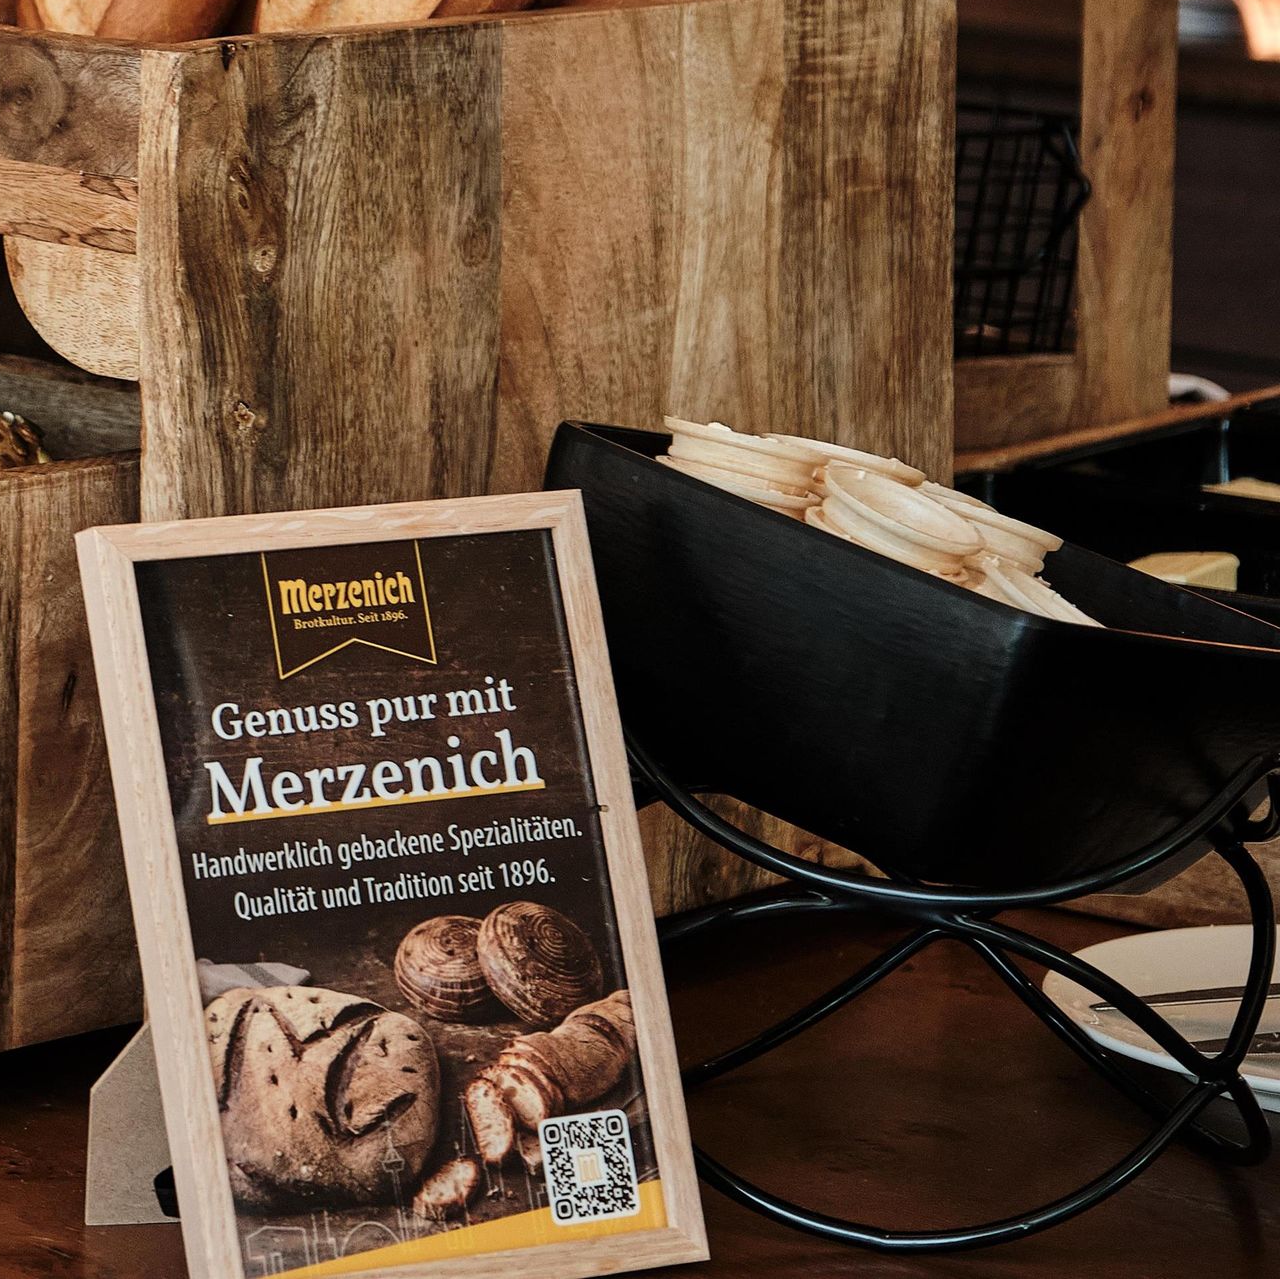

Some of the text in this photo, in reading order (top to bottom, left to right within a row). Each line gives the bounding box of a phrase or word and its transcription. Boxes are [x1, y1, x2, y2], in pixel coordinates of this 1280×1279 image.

[293, 609, 409, 630] Brotkultur. Seit 1896.
[211, 676, 518, 741] Genuss pur mit
[203, 728, 545, 820] Merzenich
[192, 815, 583, 880] Handwerklich gebackene Spezialitäten.
[233, 857, 557, 921] Qualität und Tradition seit 1896.
